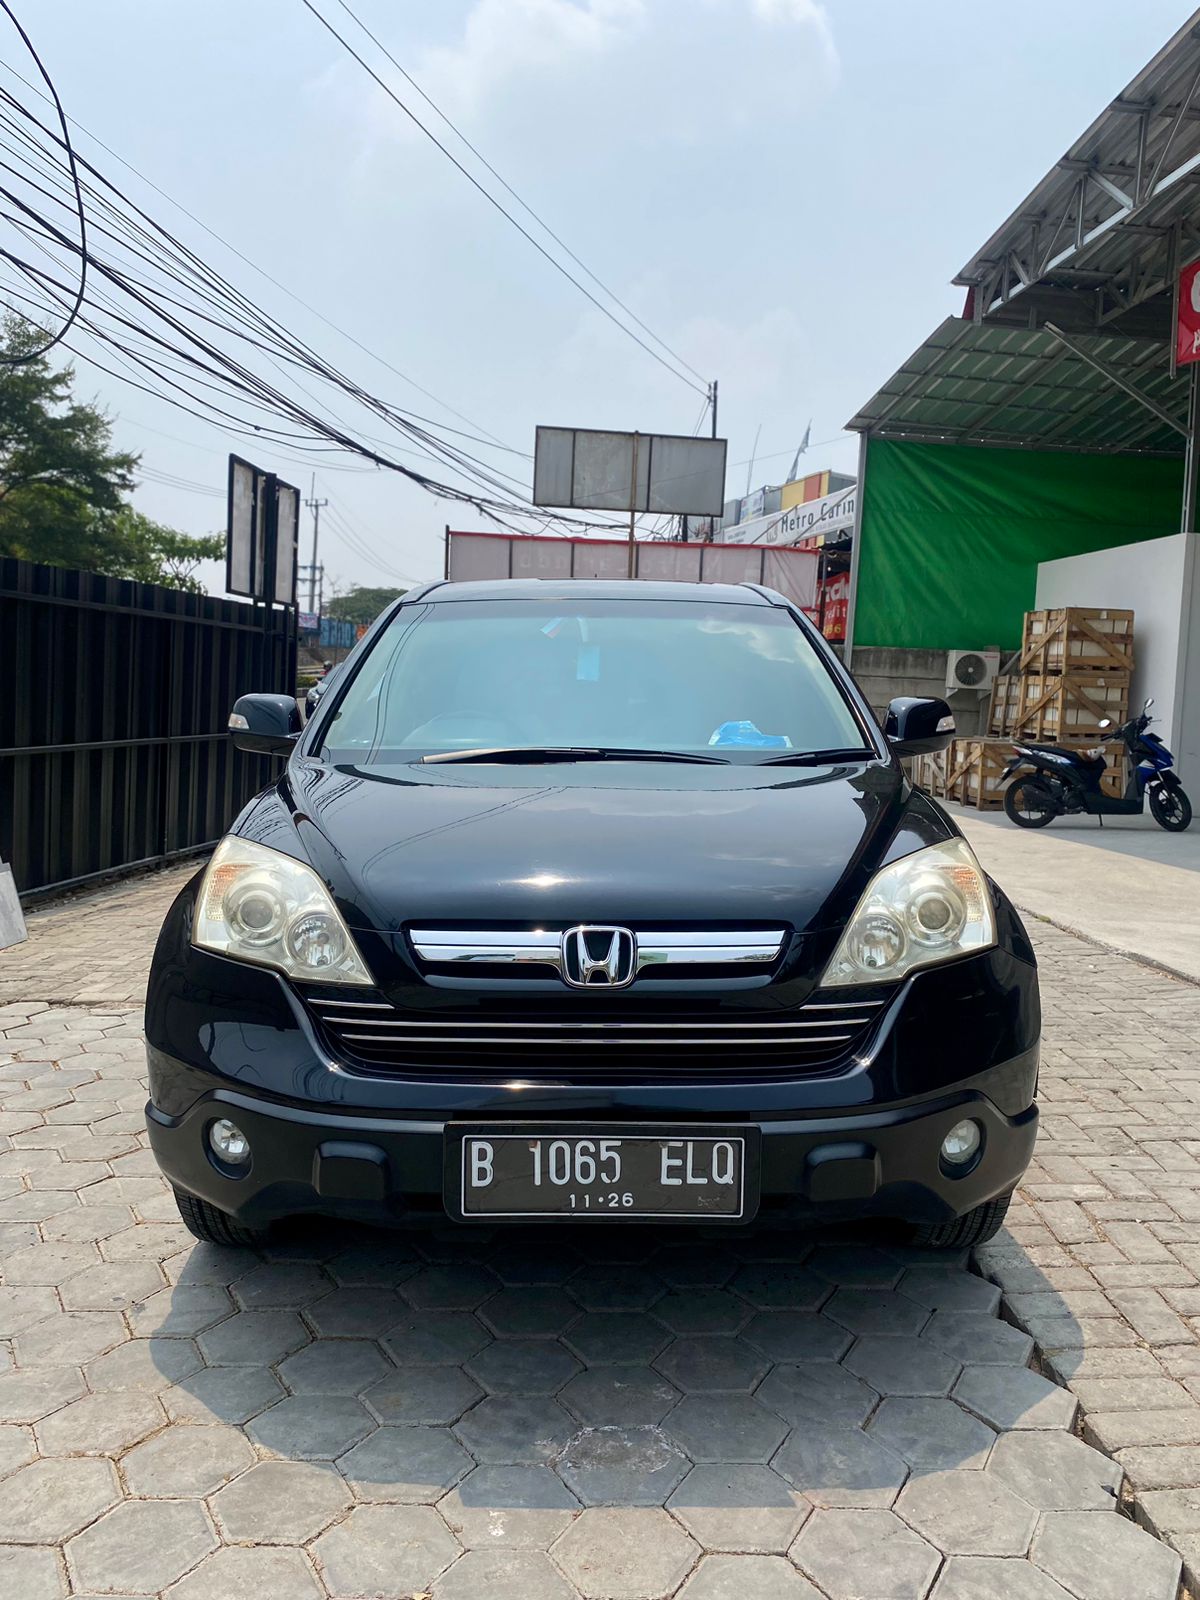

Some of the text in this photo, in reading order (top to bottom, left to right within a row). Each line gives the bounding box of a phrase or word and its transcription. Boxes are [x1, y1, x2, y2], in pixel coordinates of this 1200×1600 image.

[781, 512, 814, 534] Metro
[471, 1140, 734, 1187] B 1065 ELQ
